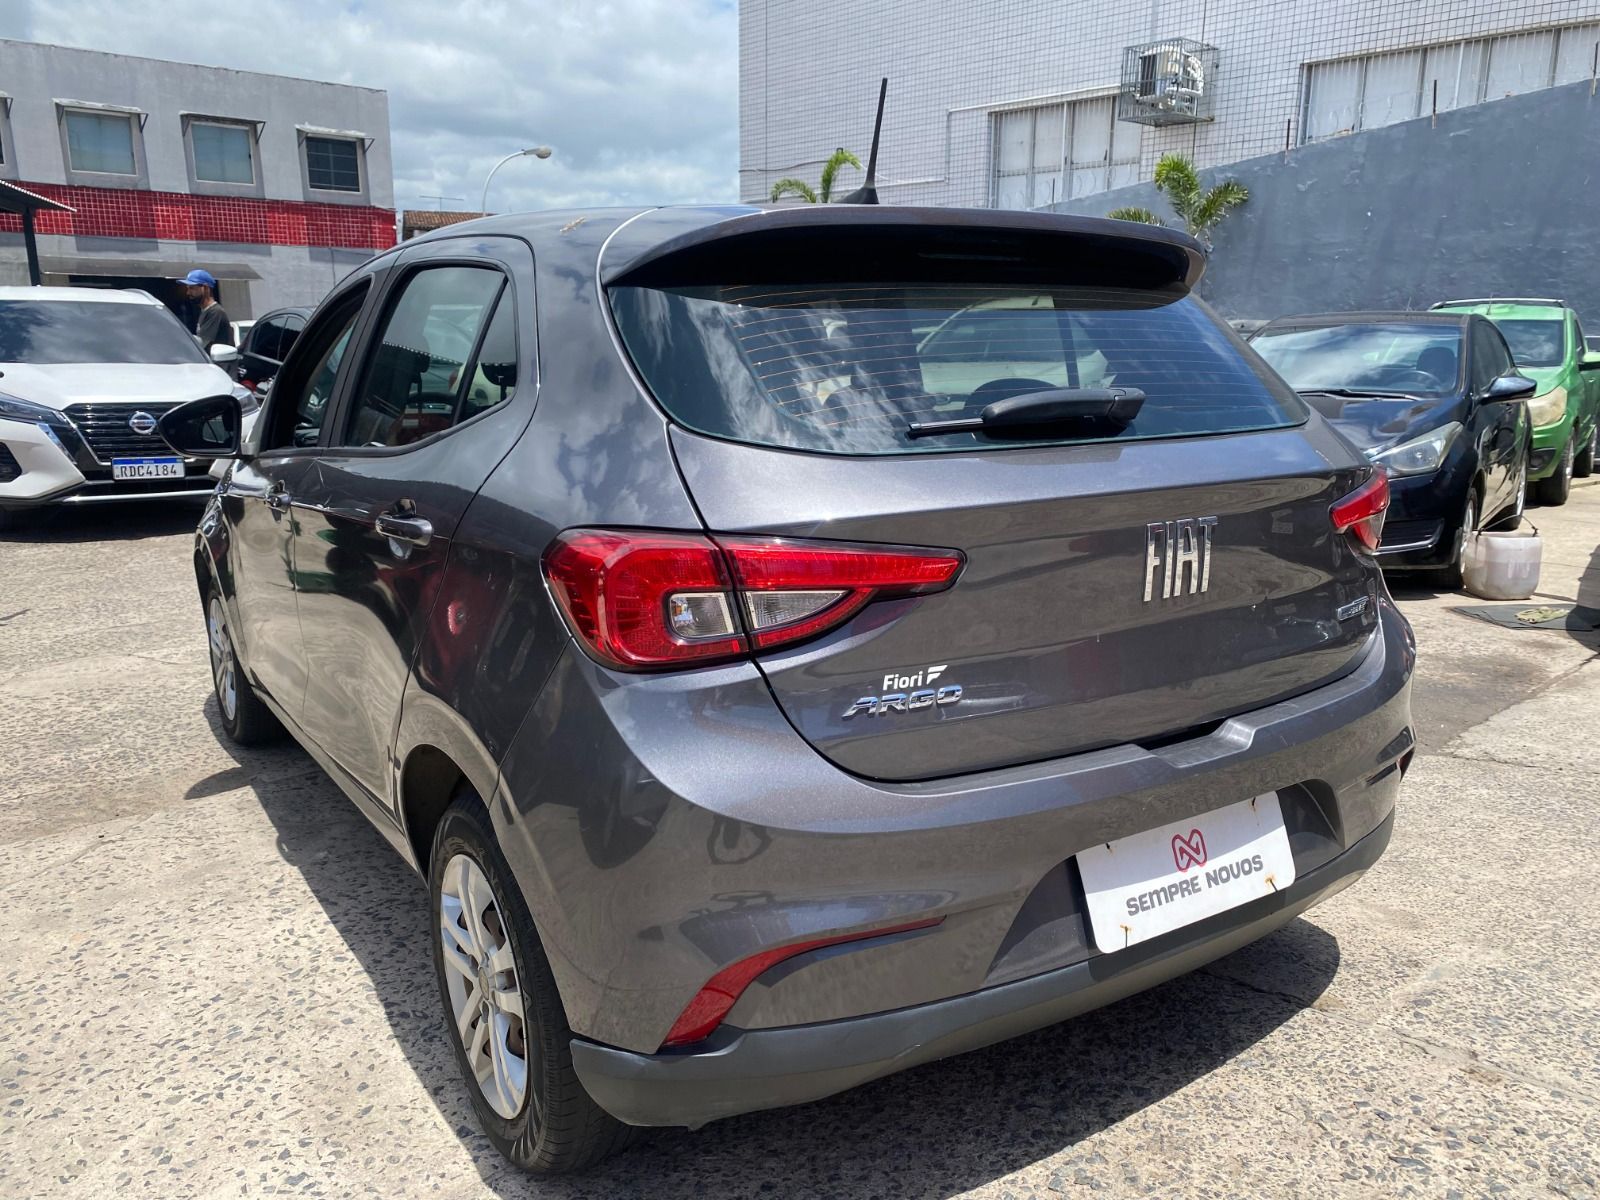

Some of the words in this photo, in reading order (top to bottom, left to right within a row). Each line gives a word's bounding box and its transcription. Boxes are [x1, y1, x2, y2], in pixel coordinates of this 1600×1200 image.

[1144, 516, 1218, 602] FIAT
[883, 671, 923, 691] Fiori
[841, 684, 963, 721] ARGO
[1126, 875, 1202, 917] SEMPRE
